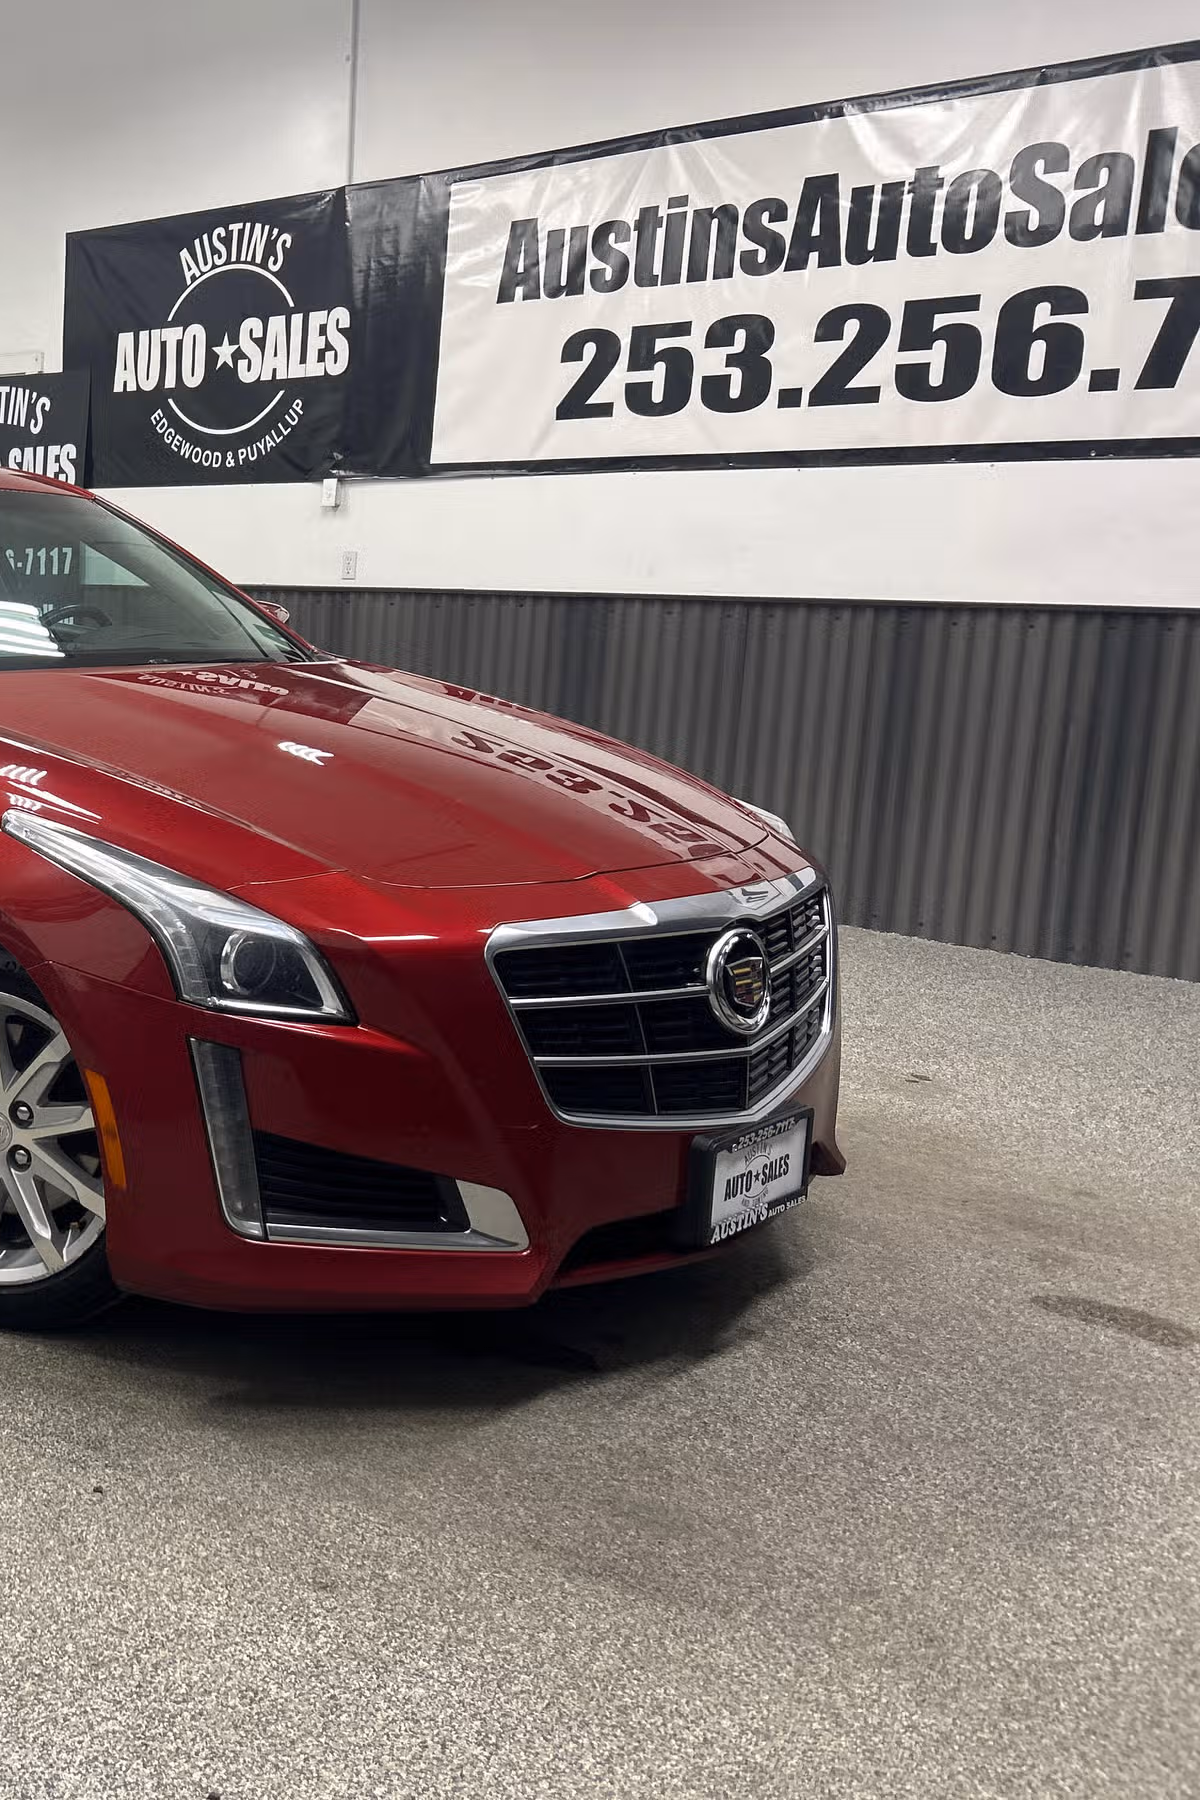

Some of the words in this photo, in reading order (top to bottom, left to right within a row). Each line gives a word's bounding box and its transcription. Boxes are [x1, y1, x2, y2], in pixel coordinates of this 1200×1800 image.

[179, 222, 292, 286] AUSTIN'S
[113, 323, 206, 393] AUTO
[237, 306, 351, 384] SALES
[150, 408, 222, 468] EDGEWOOD
[225, 451, 236, 468] &
[237, 398, 305, 466] PUYALLUP
[724, 1169, 753, 1202] AUTO
[760, 1153, 790, 1186] SALES
[710, 1203, 769, 1244] AUSTIN'S
[768, 1204, 786, 1218] AUTO
[786, 1195, 807, 1210] SALES
